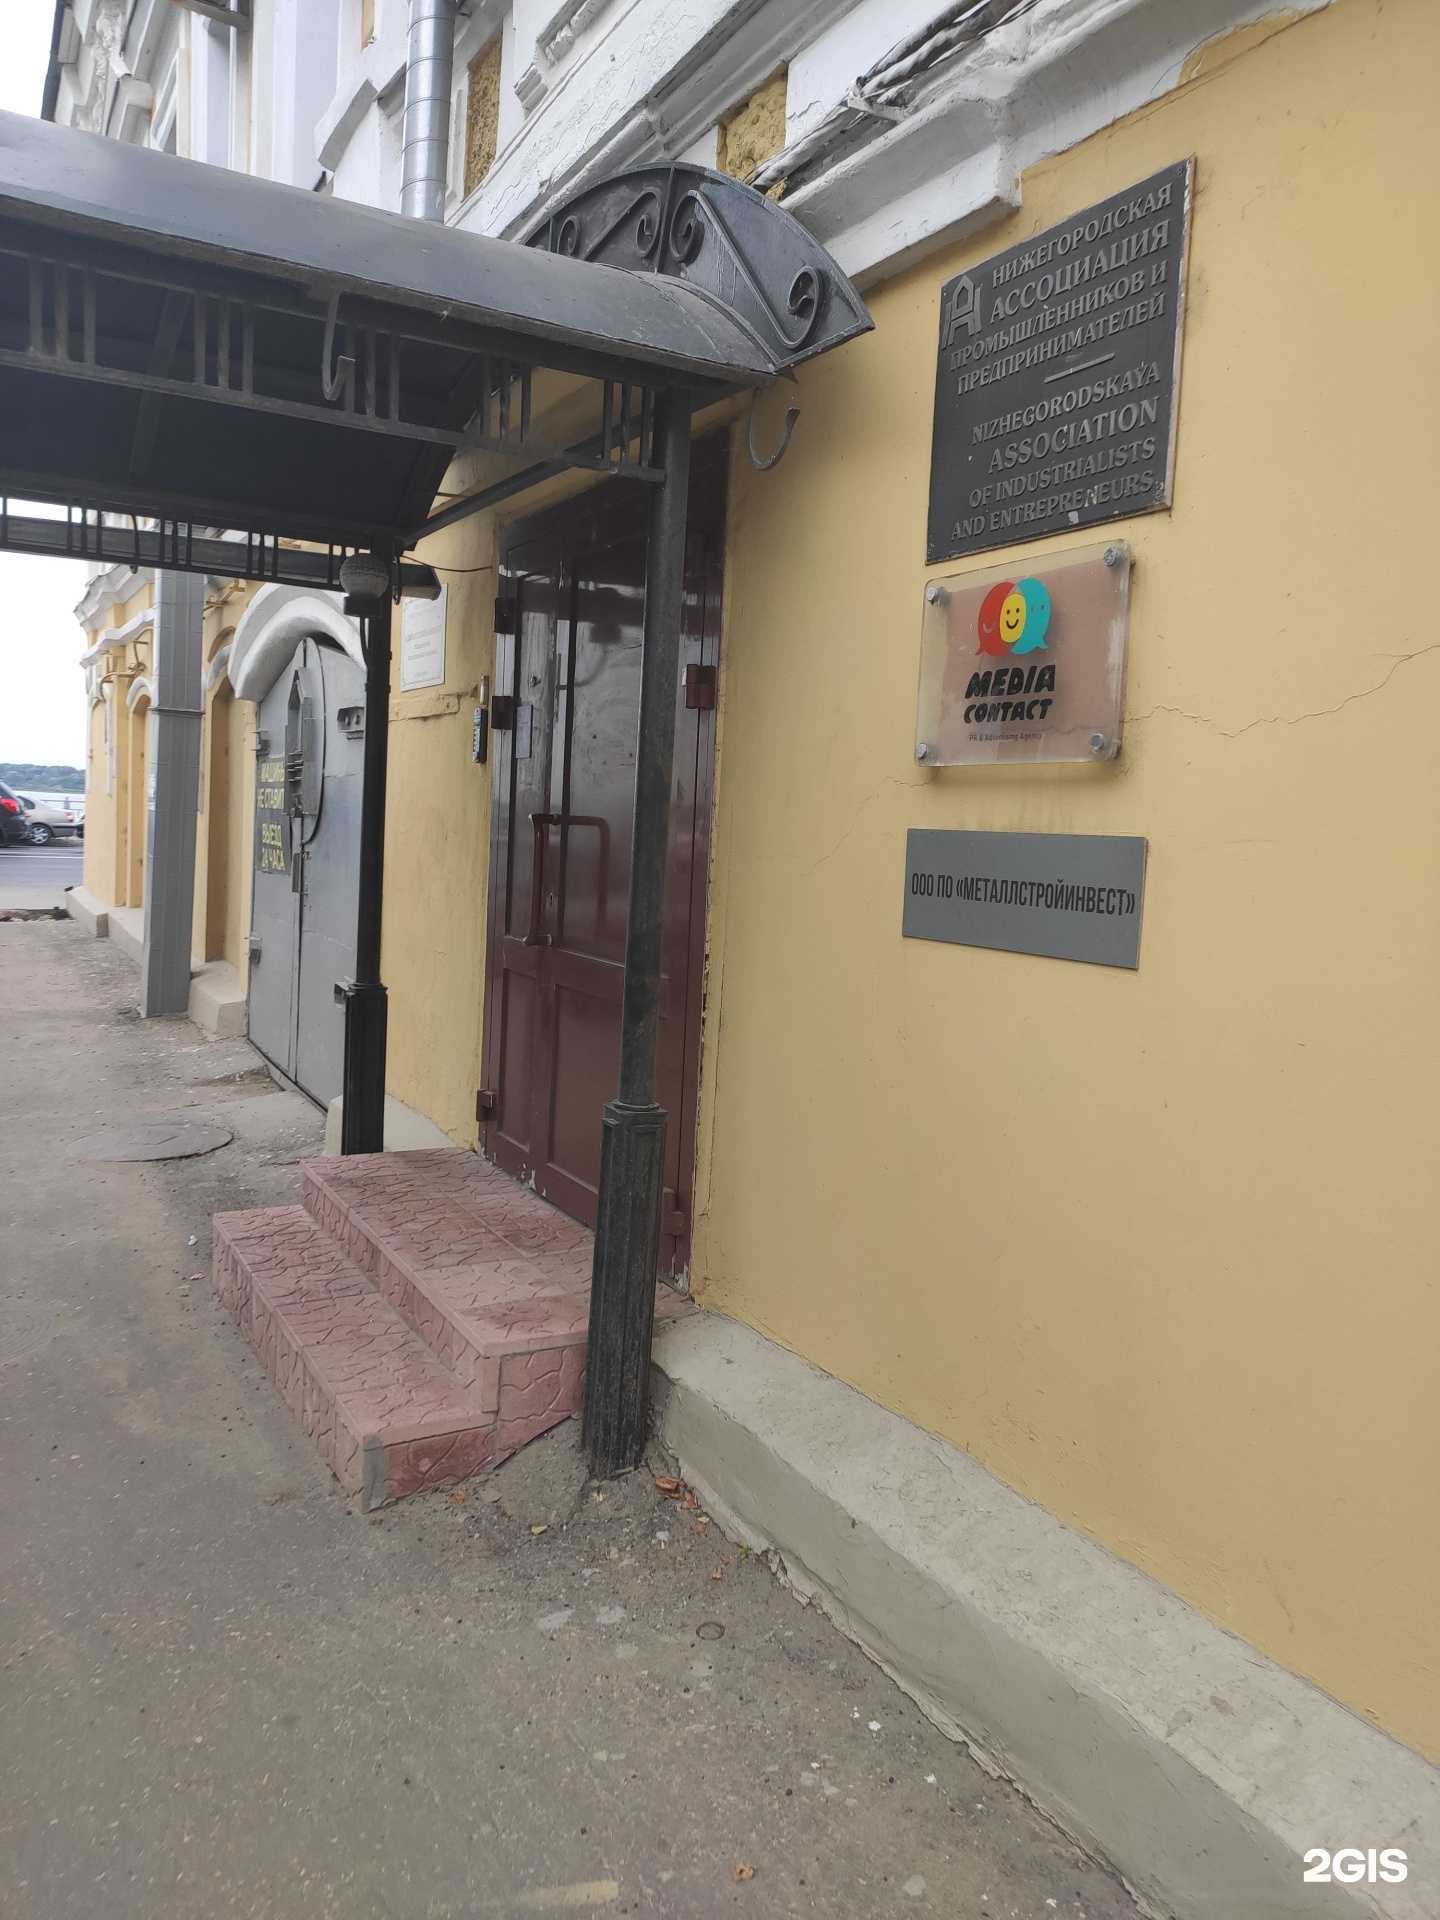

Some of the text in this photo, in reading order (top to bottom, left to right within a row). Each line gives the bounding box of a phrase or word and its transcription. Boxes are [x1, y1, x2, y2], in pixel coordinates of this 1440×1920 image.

[990, 220, 1169, 323] АССОЦИАЦИЯ
[993, 184, 1172, 288] НИЖЕГОРОДСКАЯ
[950, 260, 1168, 370] ПРОМЫШЛЕННИКОВ И
[957, 291, 1166, 396] ПРЕДПРИНИМАТЕЛЕЙ
[968, 436, 1156, 508] OF INDUSTRIALISTS
[988, 396, 1160, 474] ASSOCIATION
[951, 471, 1154, 541] AND ENTREPRENEURS
[964, 698, 1053, 724] CONTACT
[965, 664, 1056, 699] MEDIA
[911, 872, 1136, 916] ООО ПО «МЕТАЛЛСТРОЙИНВЕСТ»
